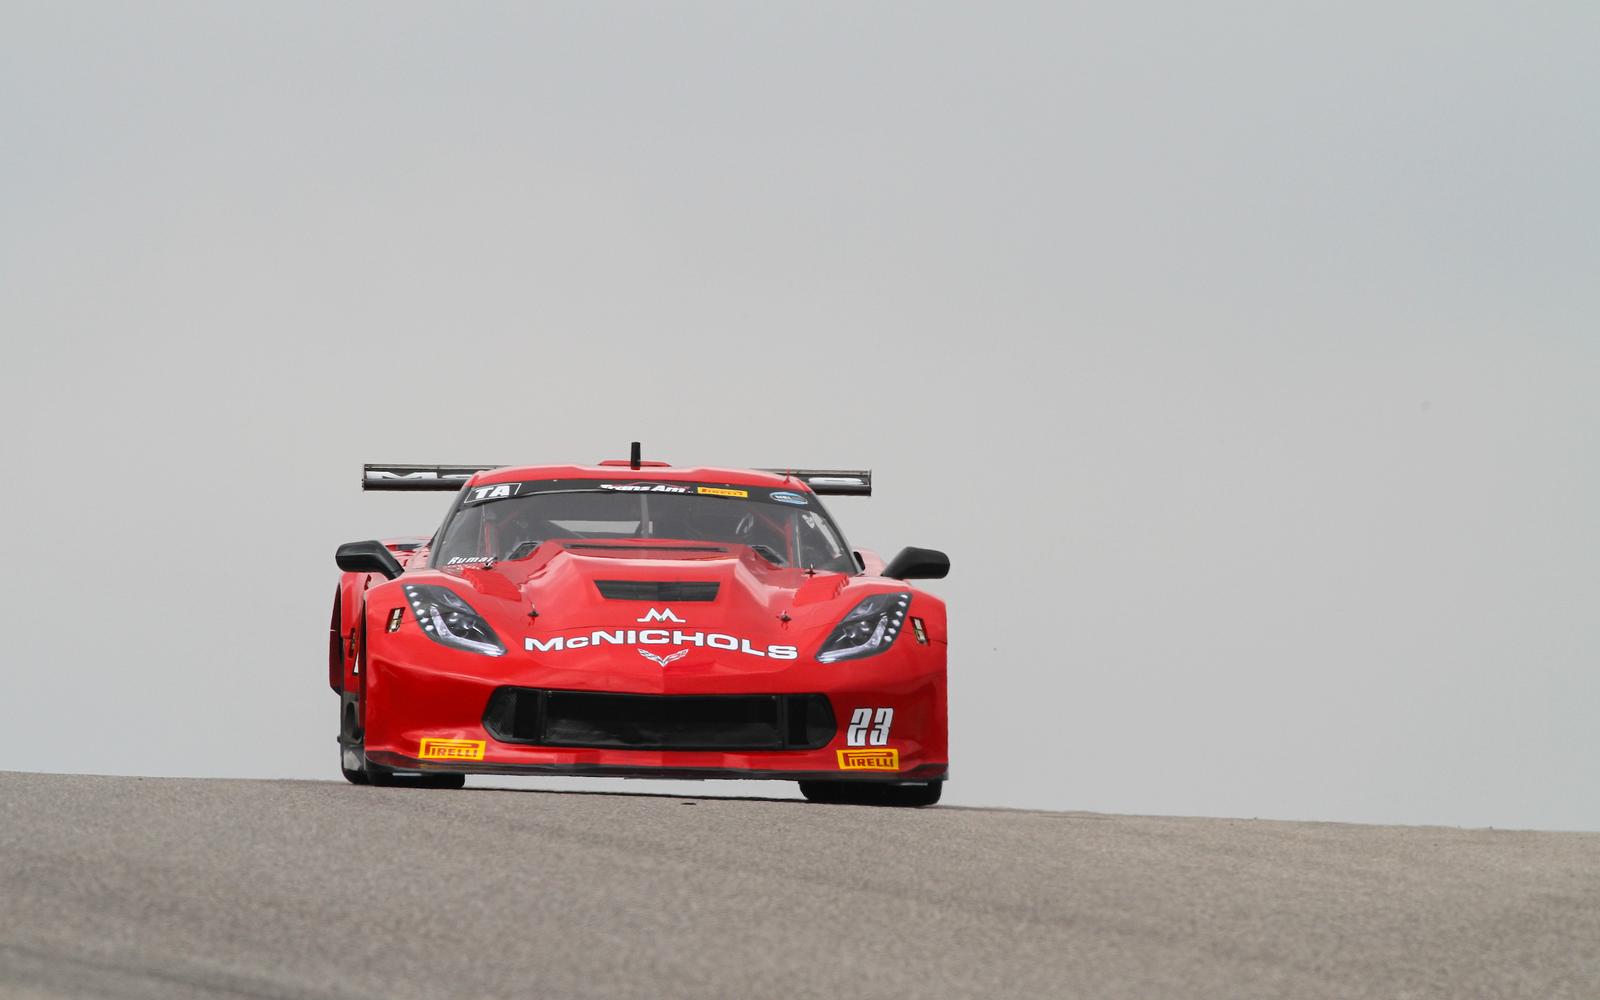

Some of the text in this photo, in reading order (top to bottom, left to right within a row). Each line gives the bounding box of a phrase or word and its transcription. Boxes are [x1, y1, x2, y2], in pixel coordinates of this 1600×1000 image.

[475, 485, 510, 500] TA
[651, 485, 686, 493] Am
[524, 629, 799, 660] McNICHOLS
[847, 707, 894, 746] 23
[424, 742, 480, 758] PIRELLI
[842, 752, 894, 768] PIRELLI
